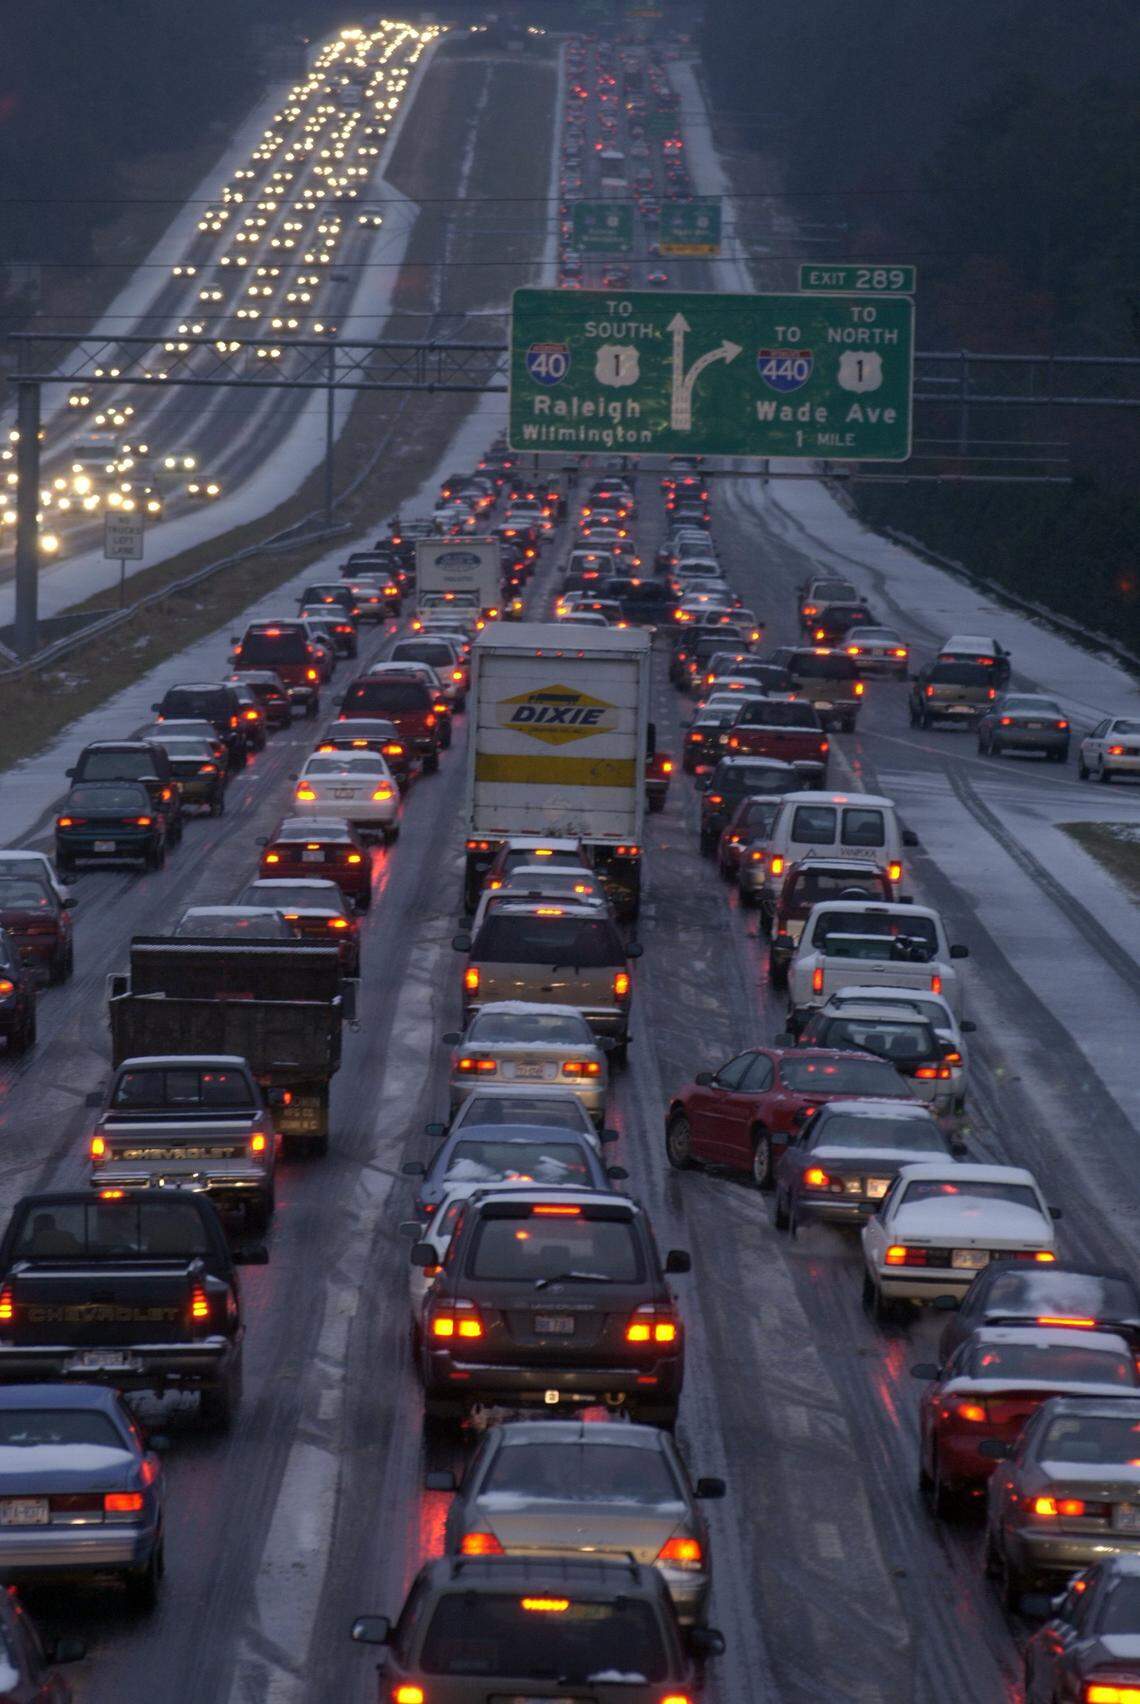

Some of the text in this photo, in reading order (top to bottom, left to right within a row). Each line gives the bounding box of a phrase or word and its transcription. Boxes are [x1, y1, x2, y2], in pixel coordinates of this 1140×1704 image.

[809, 269, 905, 289] EXIT 289
[605, 301, 633, 317] TO
[850, 306, 877, 323] TO
[584, 321, 653, 339] SOUTH
[774, 326, 801, 343] TO
[827, 327, 899, 345] NORTH
[530, 353, 566, 379] 40
[613, 353, 621, 377] 1
[762, 358, 809, 381] 440
[856, 359, 864, 383] 1
[533, 395, 641, 424] Raleigh
[756, 400, 898, 424] Wade Ave
[522, 423, 653, 447] Wilmington
[796, 430, 856, 448] 1 MILE
[510, 706, 606, 725] DIXIE
[27, 1304, 179, 1323] CHEVROLET
